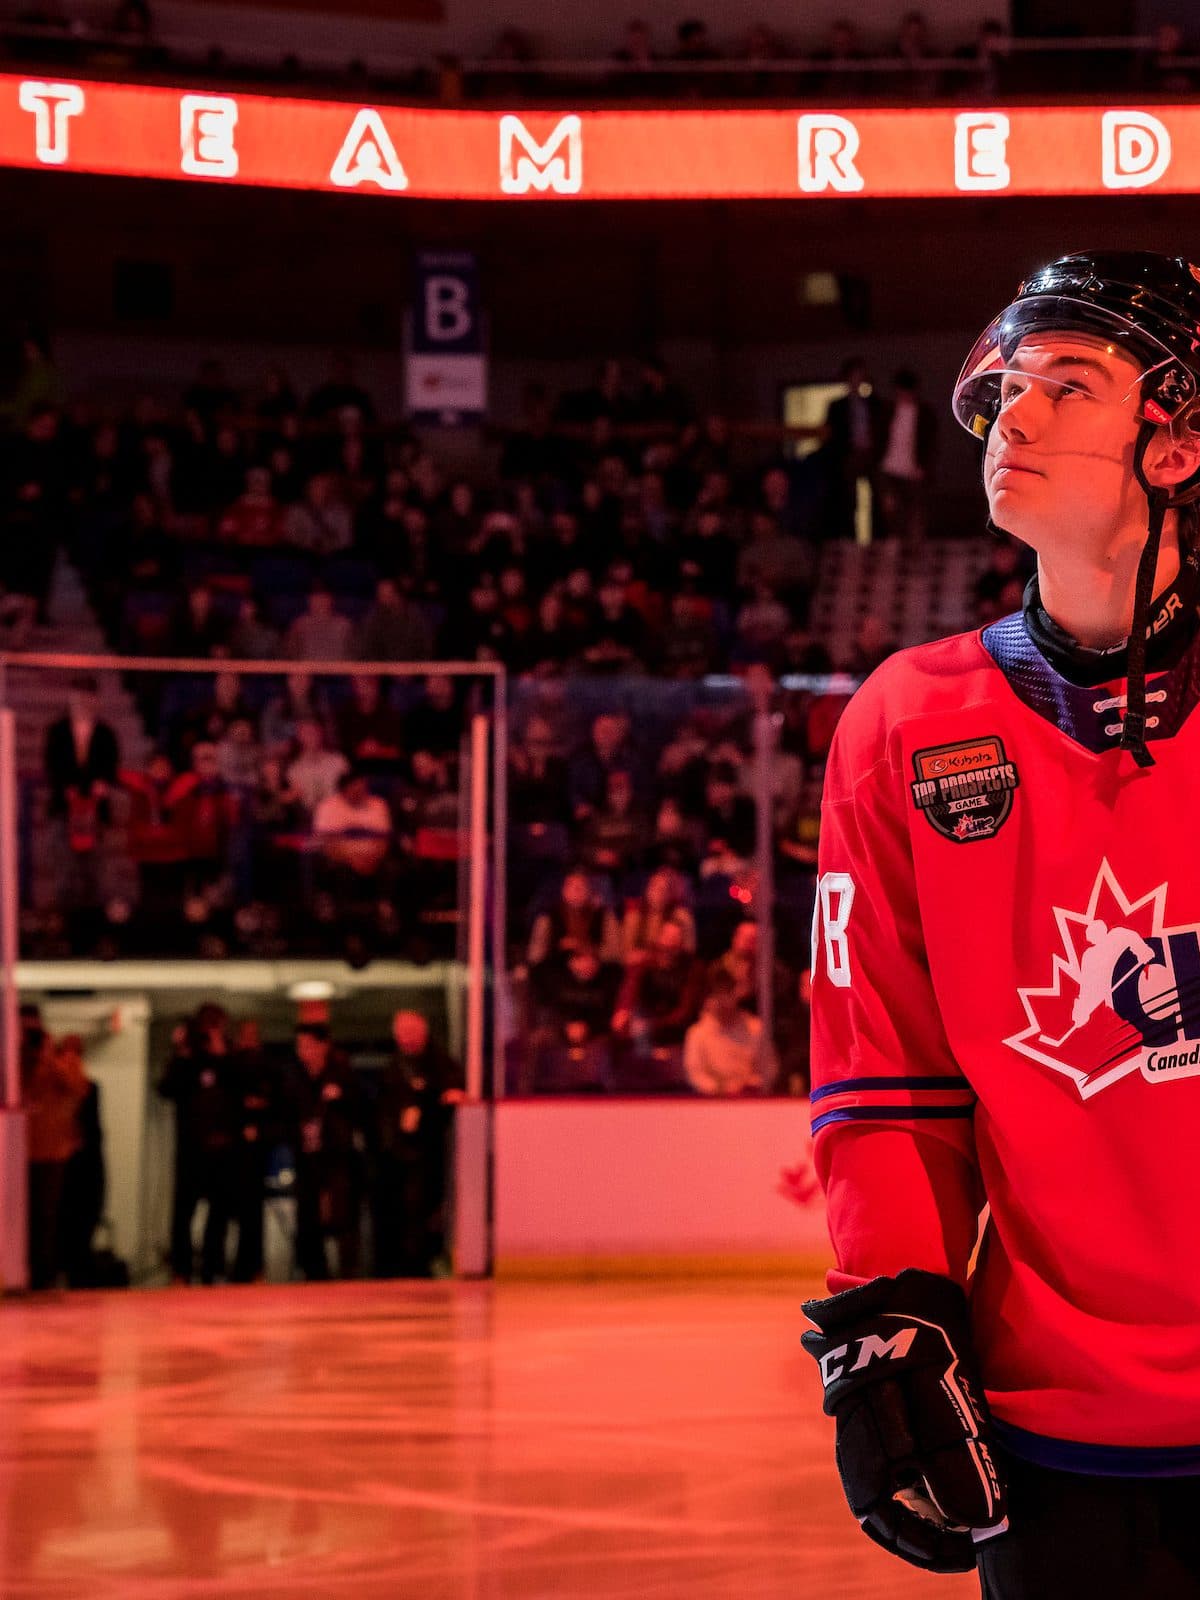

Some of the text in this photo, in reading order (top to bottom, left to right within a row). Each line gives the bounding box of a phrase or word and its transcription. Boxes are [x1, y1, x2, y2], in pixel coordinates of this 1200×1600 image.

[19, 80, 1171, 194] TEAM RED
[424, 274, 472, 341] B
[913, 764, 1016, 806] TOP PROSPECTS
[948, 753, 992, 766] Kubota
[955, 798, 982, 810] GAME
[810, 872, 856, 987] 8
